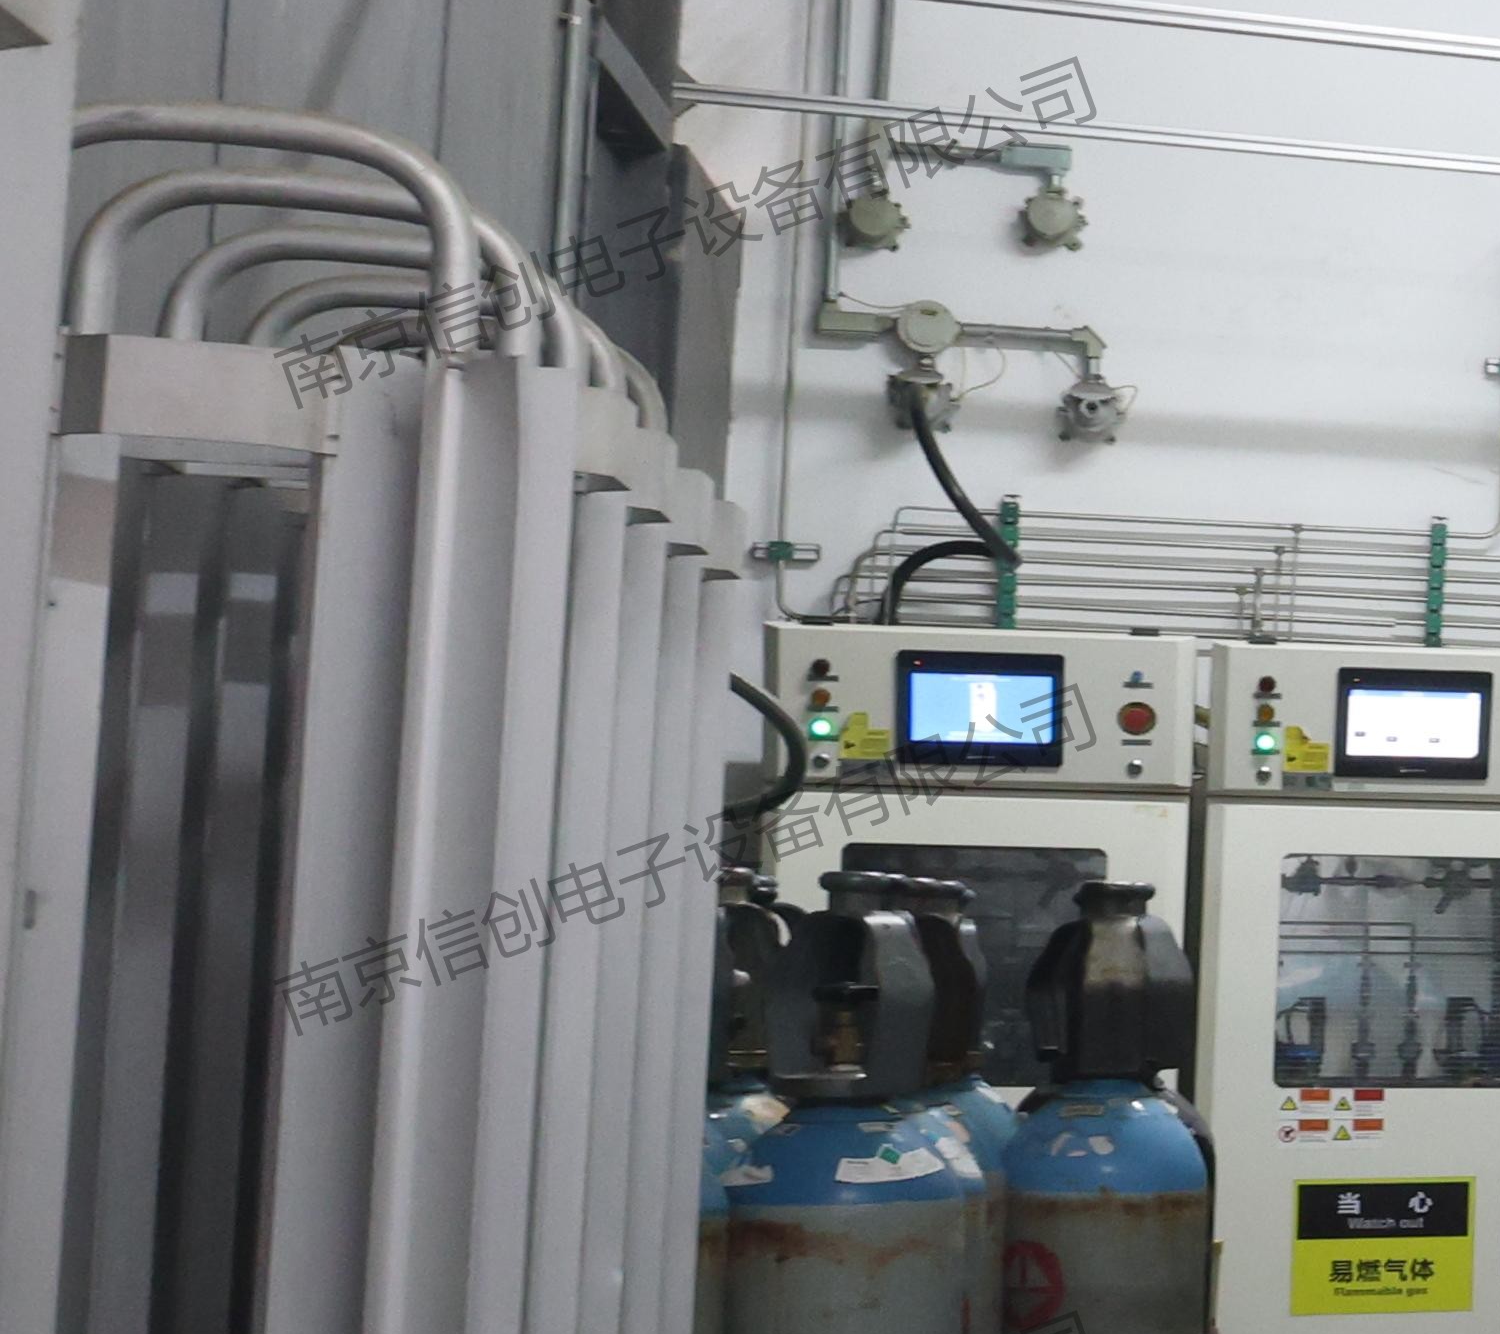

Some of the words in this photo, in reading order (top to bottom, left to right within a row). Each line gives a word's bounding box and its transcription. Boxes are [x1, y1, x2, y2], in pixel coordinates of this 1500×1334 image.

[1336, 1191, 1434, 1215] 当心
[1347, 1217, 1397, 1230] Watch
[1399, 1217, 1424, 1229] out
[1329, 1258, 1435, 1284] 易燃气体
